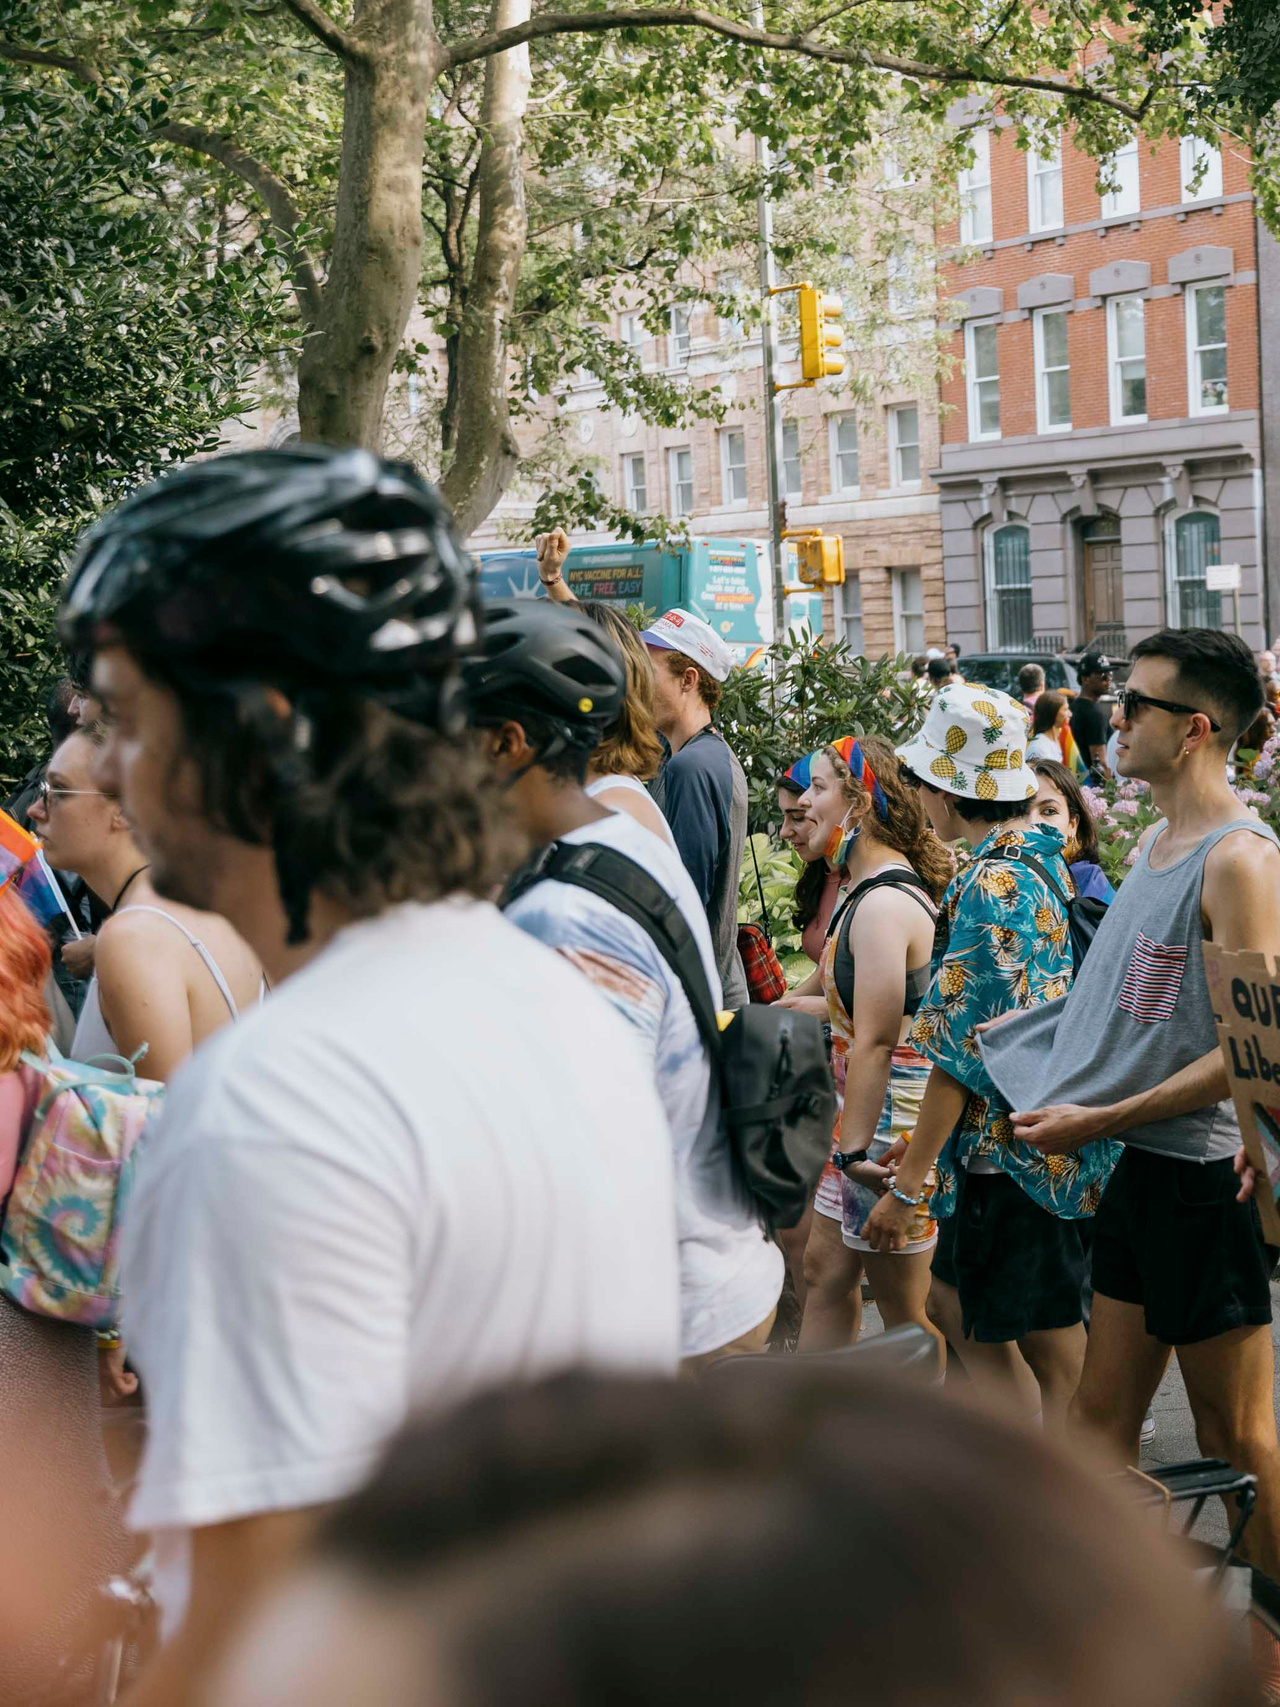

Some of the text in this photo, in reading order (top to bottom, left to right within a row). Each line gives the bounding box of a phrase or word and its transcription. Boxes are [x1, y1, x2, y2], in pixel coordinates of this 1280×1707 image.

[570, 570, 583, 581] NYC
[584, 569, 612, 581] VACCINE
[613, 568, 626, 579] FOR
[618, 580, 642, 594] EASY
